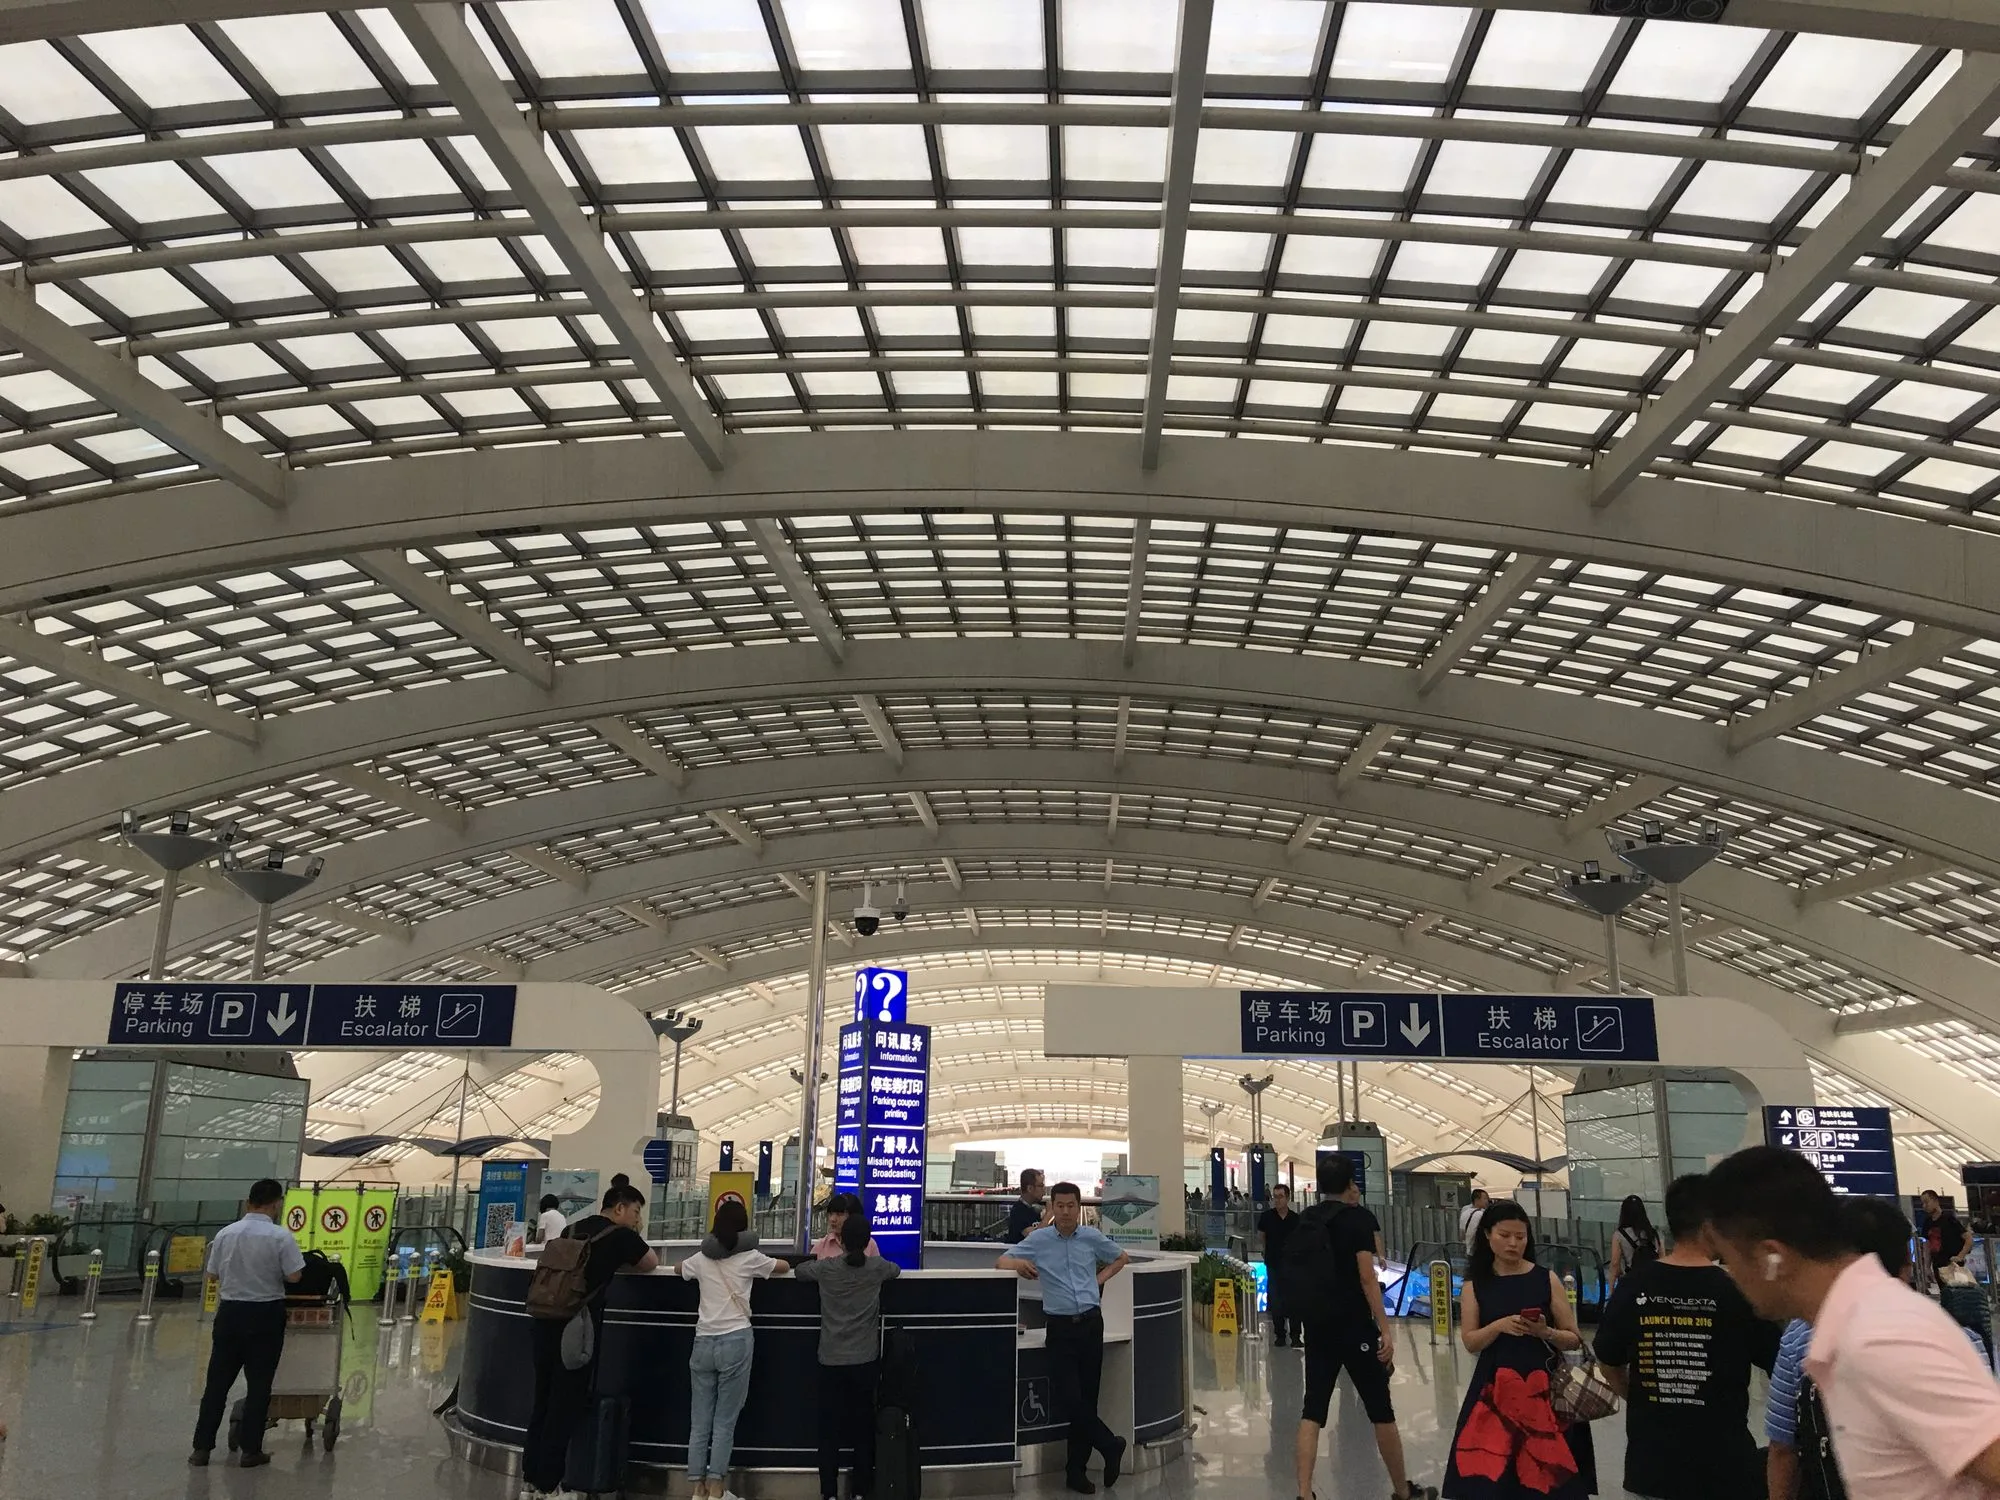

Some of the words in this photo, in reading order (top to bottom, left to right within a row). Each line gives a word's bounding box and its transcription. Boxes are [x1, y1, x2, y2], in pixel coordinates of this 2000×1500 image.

[122, 991, 204, 1015] 停车场
[354, 995, 421, 1019] 扶梯
[1248, 1000, 1332, 1025] 停车场
[220, 1001, 244, 1028] P
[1352, 1010, 1375, 1038] P
[1488, 1005, 1558, 1031] 扶梯
[125, 1018, 194, 1038] Parking
[340, 1021, 429, 1037] Escalator
[1256, 1027, 1326, 1047] Parking
[875, 1031, 923, 1052] 问讯服务
[1478, 1032, 1570, 1051] Escalator
[880, 1052, 918, 1063] Information
[871, 1076, 923, 1095] 停车券打印
[873, 1096, 896, 1108] Parking
[897, 1098, 920, 1108] coupon
[884, 1109, 908, 1120] printing
[870, 1135, 919, 1154] 广播寻人
[1821, 1133, 1833, 1146] P
[867, 1156, 893, 1168] Missing
[895, 1157, 921, 1167] Persons
[872, 1168, 916, 1180] Broadcasting
[875, 1194, 912, 1213] 急救箱
[872, 1216, 888, 1225] First
[890, 1216, 901, 1225] Aid
[903, 1216, 912, 1225] Kit
[1435, 1280, 1446, 1325] 手推车禁行
[1649, 1296, 1717, 1307] VENCLEXTA
[1640, 1316, 1670, 1326] LAUNCH
[1672, 1316, 1693, 1326] TOUR
[1695, 1317, 1713, 1327] 2016
